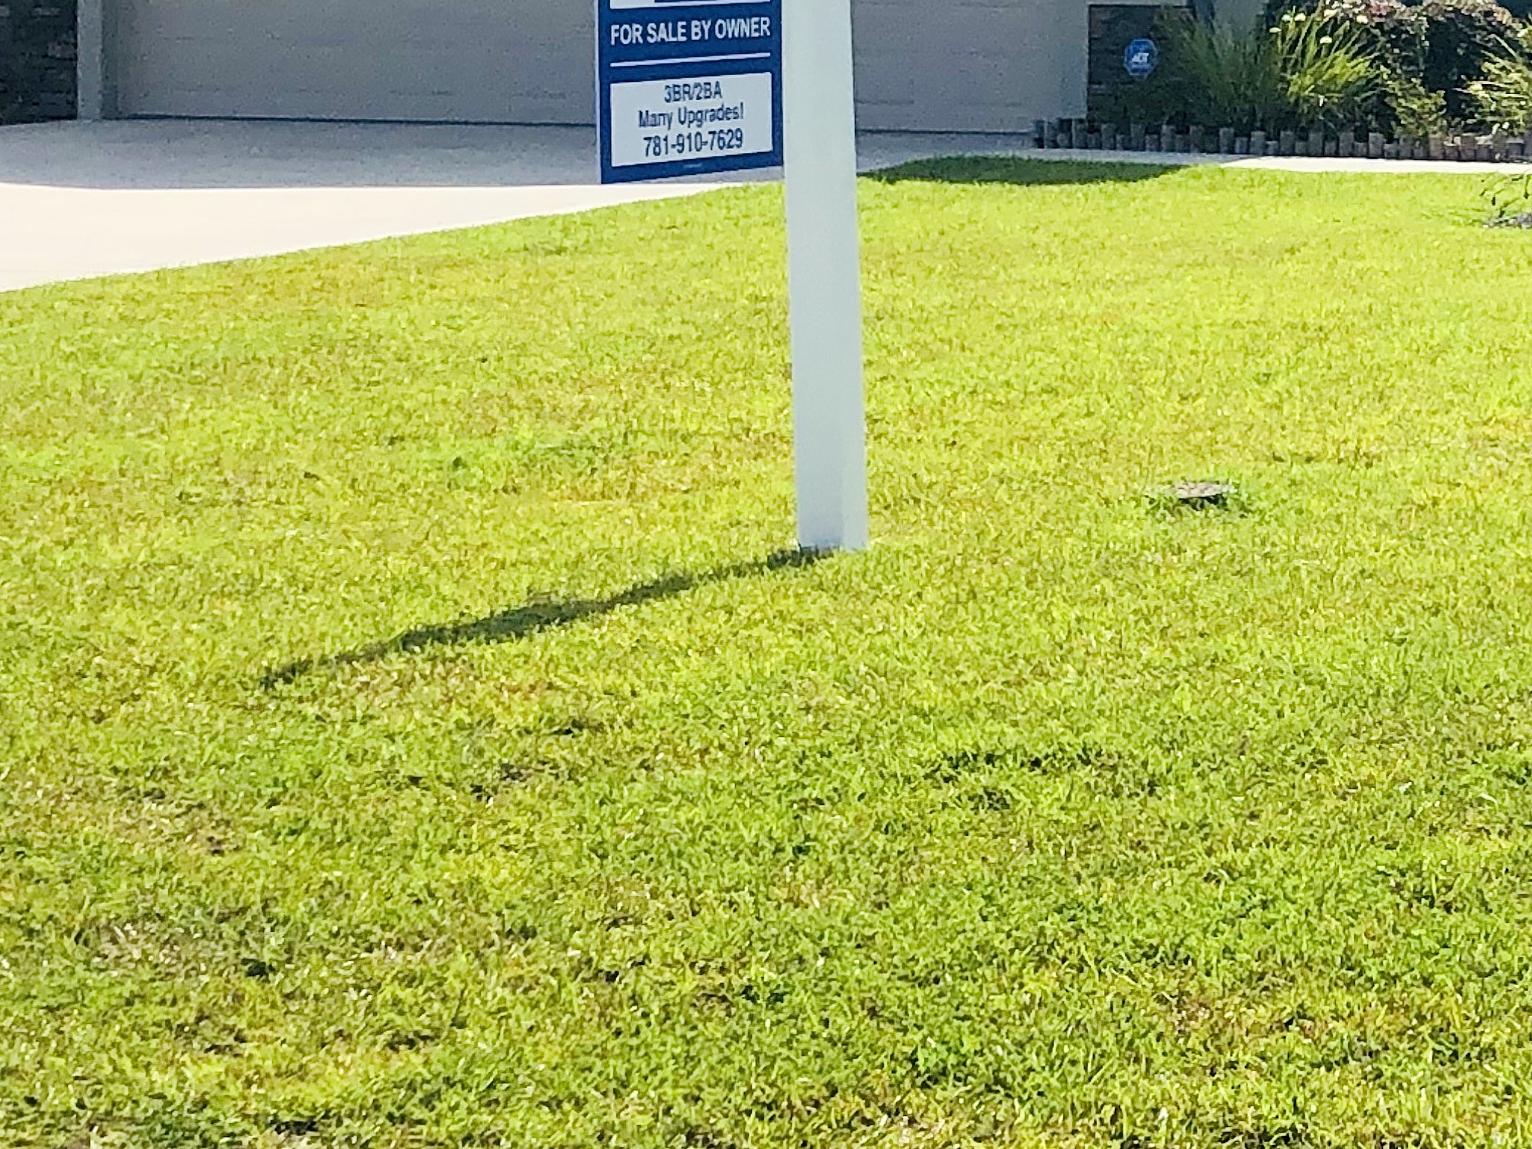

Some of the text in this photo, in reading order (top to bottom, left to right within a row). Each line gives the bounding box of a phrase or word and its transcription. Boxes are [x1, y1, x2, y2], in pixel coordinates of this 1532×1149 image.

[610, 16, 771, 46] FOR SALE BY OWNER
[663, 80, 723, 104] 3BR/2BA
[638, 101, 744, 131] Many Upgrades!
[643, 127, 743, 157] 781-910-7629
